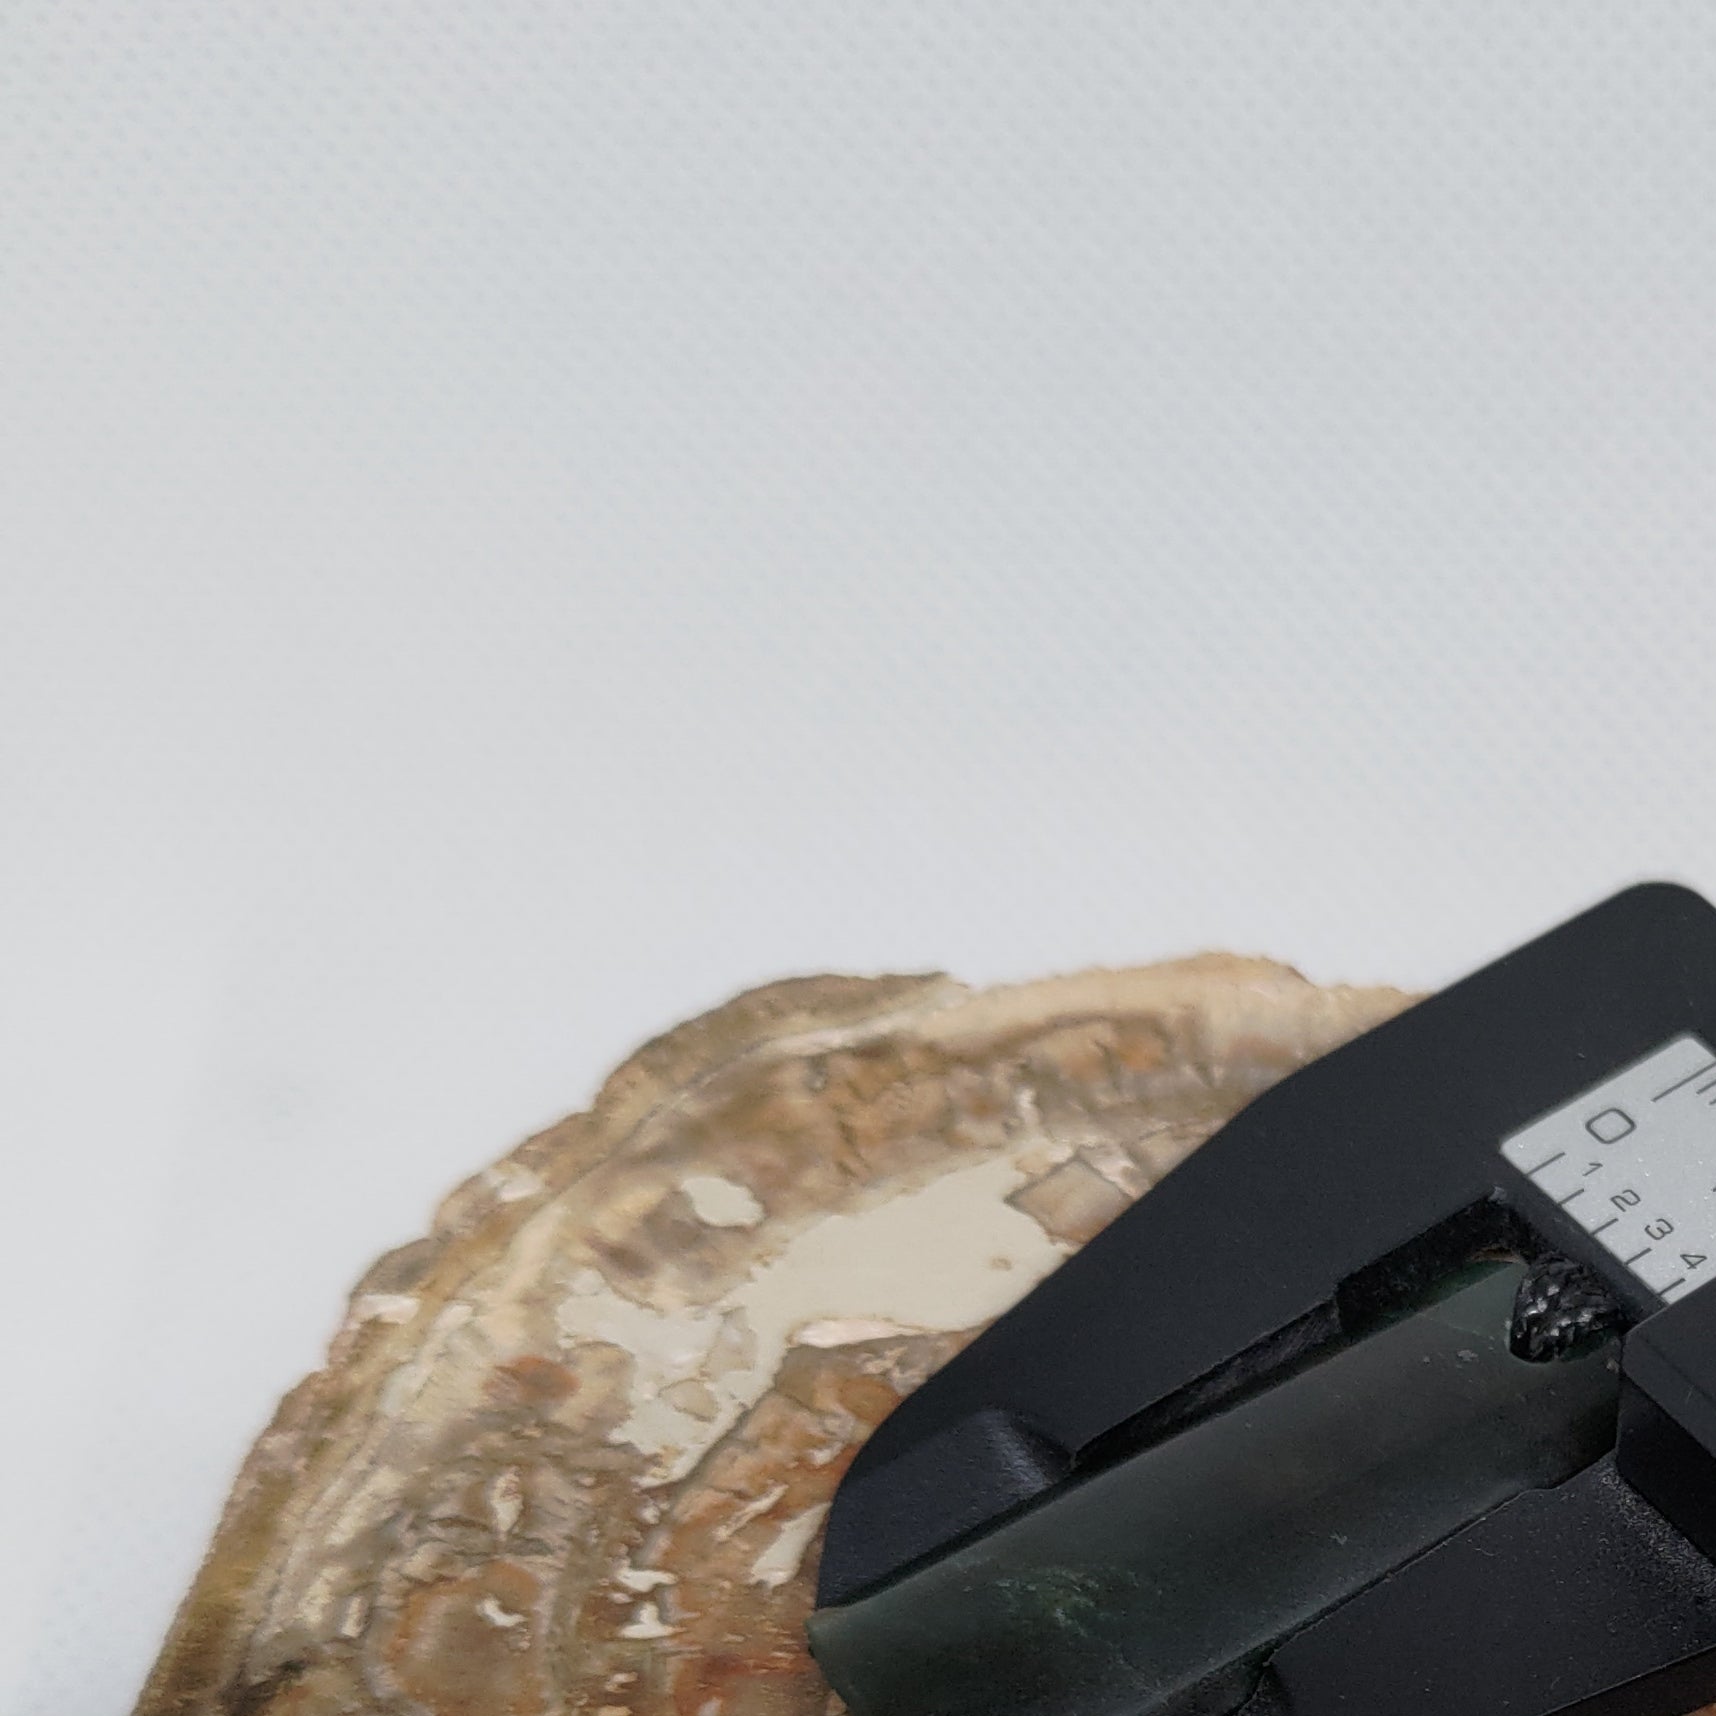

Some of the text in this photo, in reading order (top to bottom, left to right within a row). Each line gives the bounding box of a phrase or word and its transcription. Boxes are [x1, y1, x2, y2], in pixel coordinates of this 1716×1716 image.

[1585, 1107, 1637, 1145] 0
[1582, 1161, 1708, 1271] 1 2 3 4
